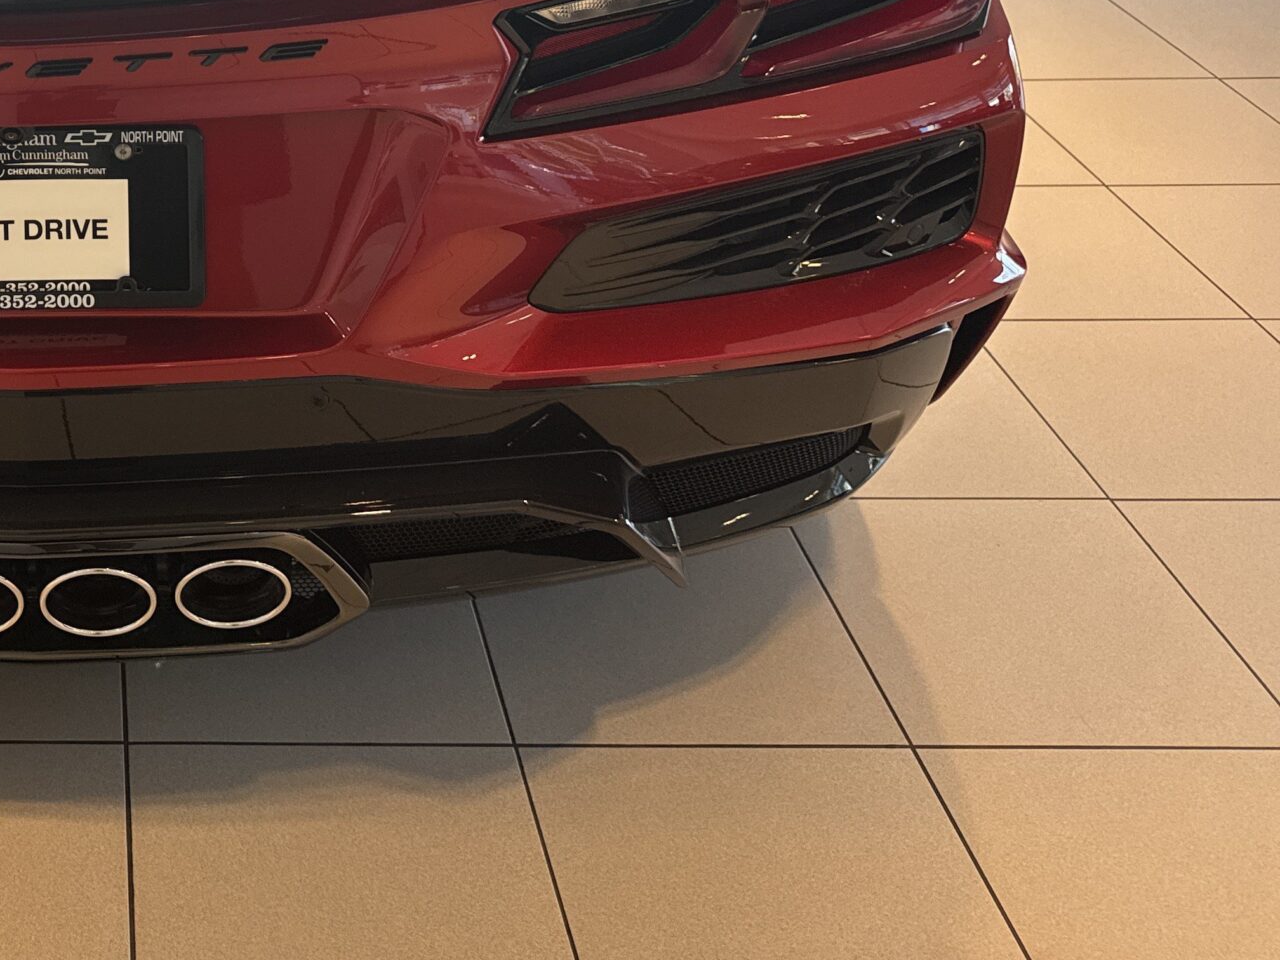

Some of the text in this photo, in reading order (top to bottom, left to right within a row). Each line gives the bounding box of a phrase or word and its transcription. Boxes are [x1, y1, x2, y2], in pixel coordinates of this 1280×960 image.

[121, 131, 153, 143] NORTH
[156, 130, 184, 142] POINT
[12, 149, 88, 162] Cunningham
[7, 167, 53, 176] CHEVROLET
[83, 167, 106, 175] POINT
[24, 218, 109, 240] DRIVE
